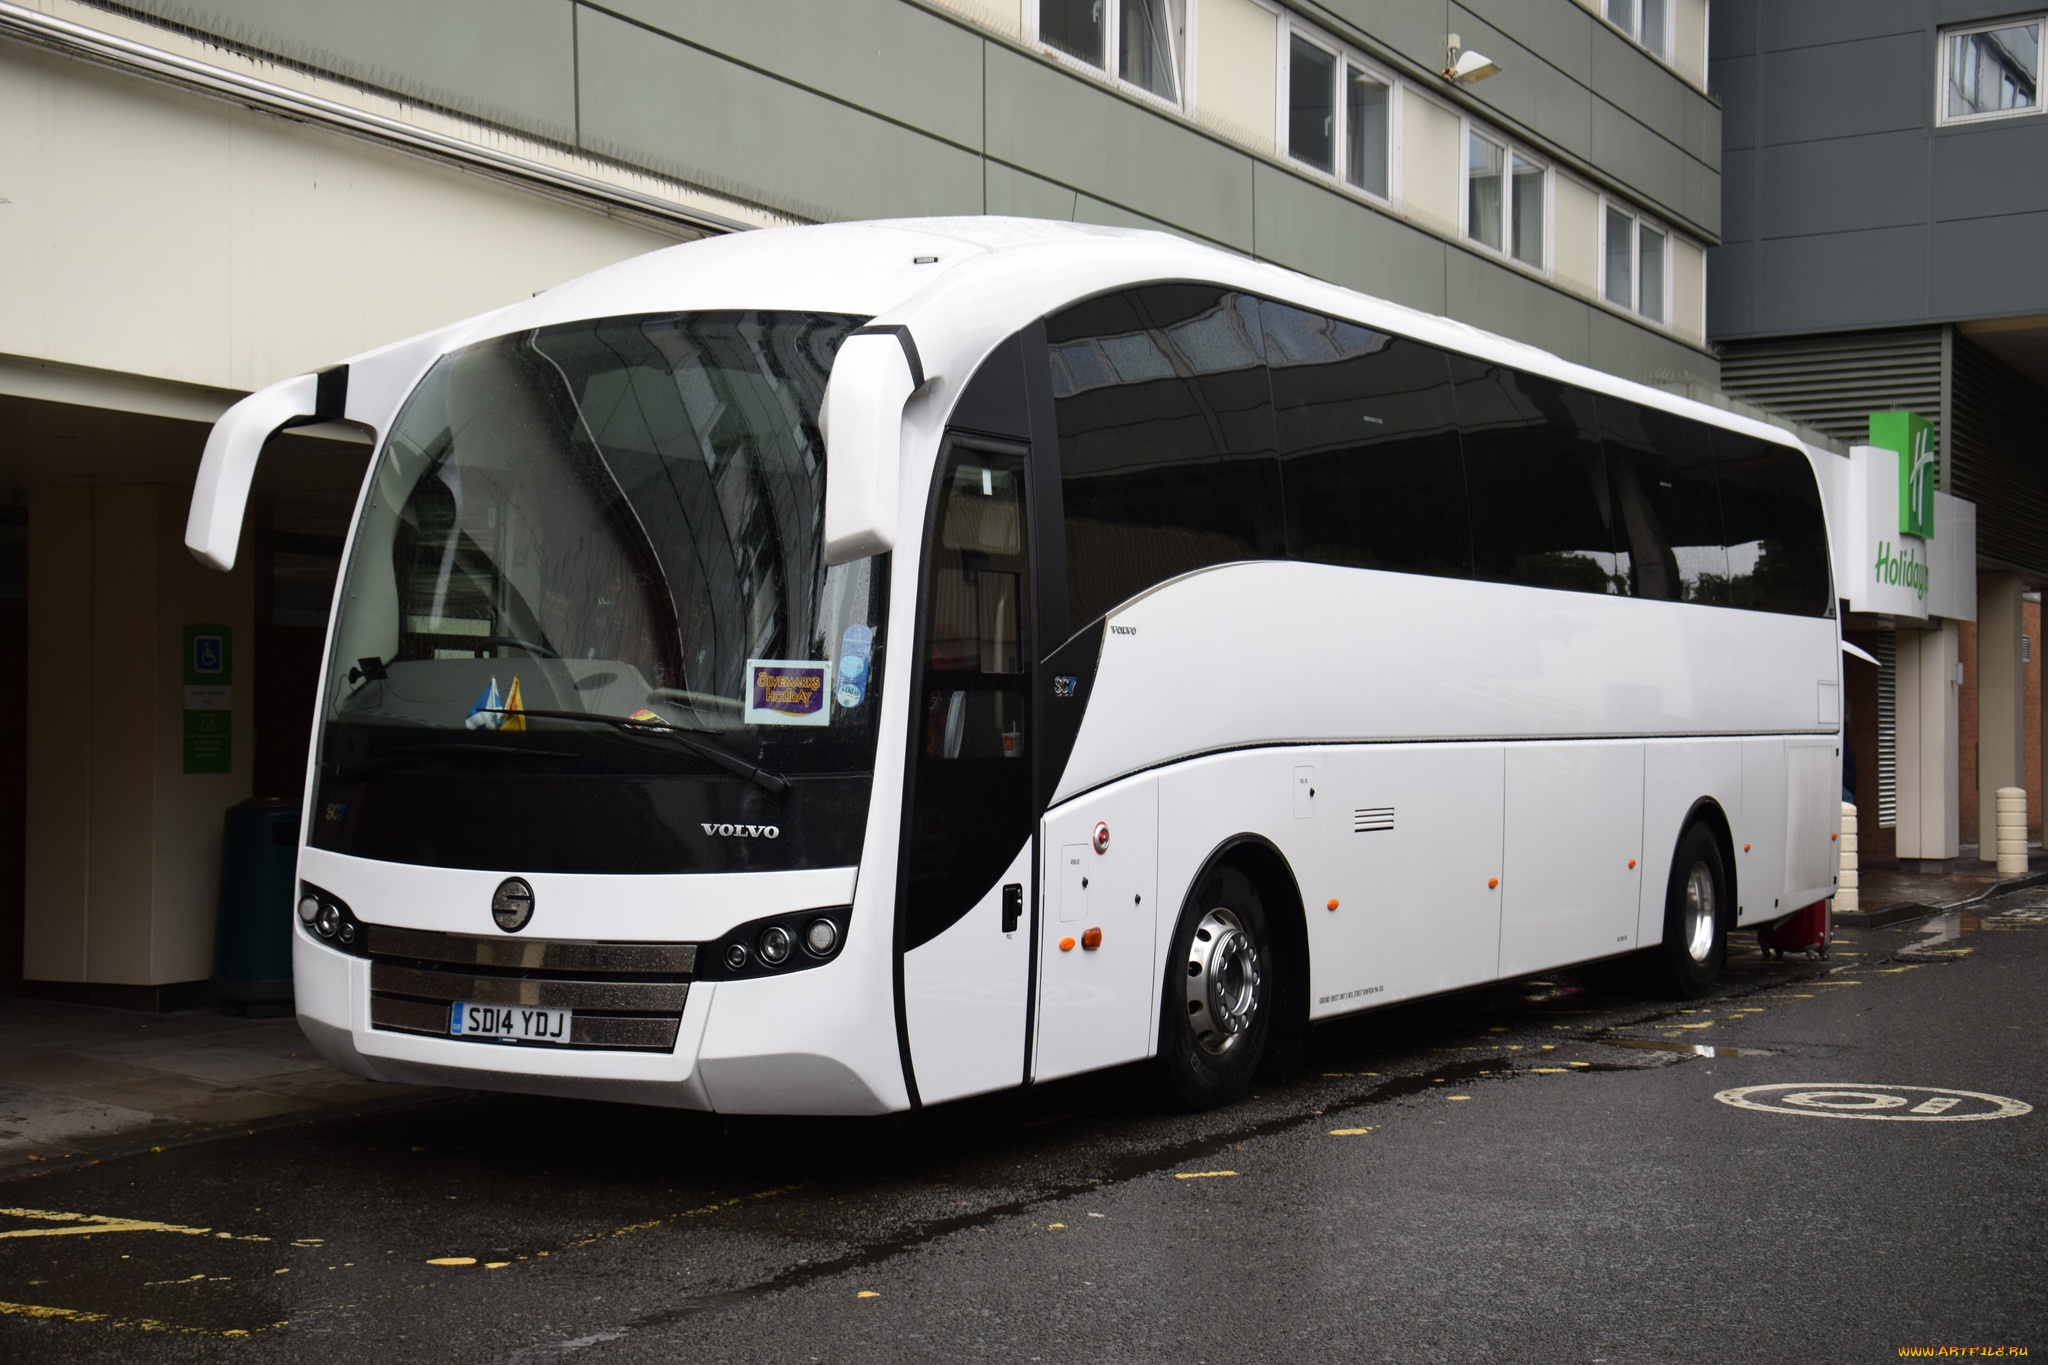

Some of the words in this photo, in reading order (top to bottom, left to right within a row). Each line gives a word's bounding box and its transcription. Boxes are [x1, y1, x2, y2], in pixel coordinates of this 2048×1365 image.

[1875, 541, 1924, 601] Holiday
[1110, 625, 1137, 636] VOLVO
[757, 671, 821, 691] ÖLVEMARKS
[1054, 675, 1077, 696] SC7
[765, 687, 813, 708] HOLIDAY
[700, 822, 780, 839] VOLVO
[468, 1007, 514, 1035] SD14
[521, 1010, 564, 1038] YDJ
